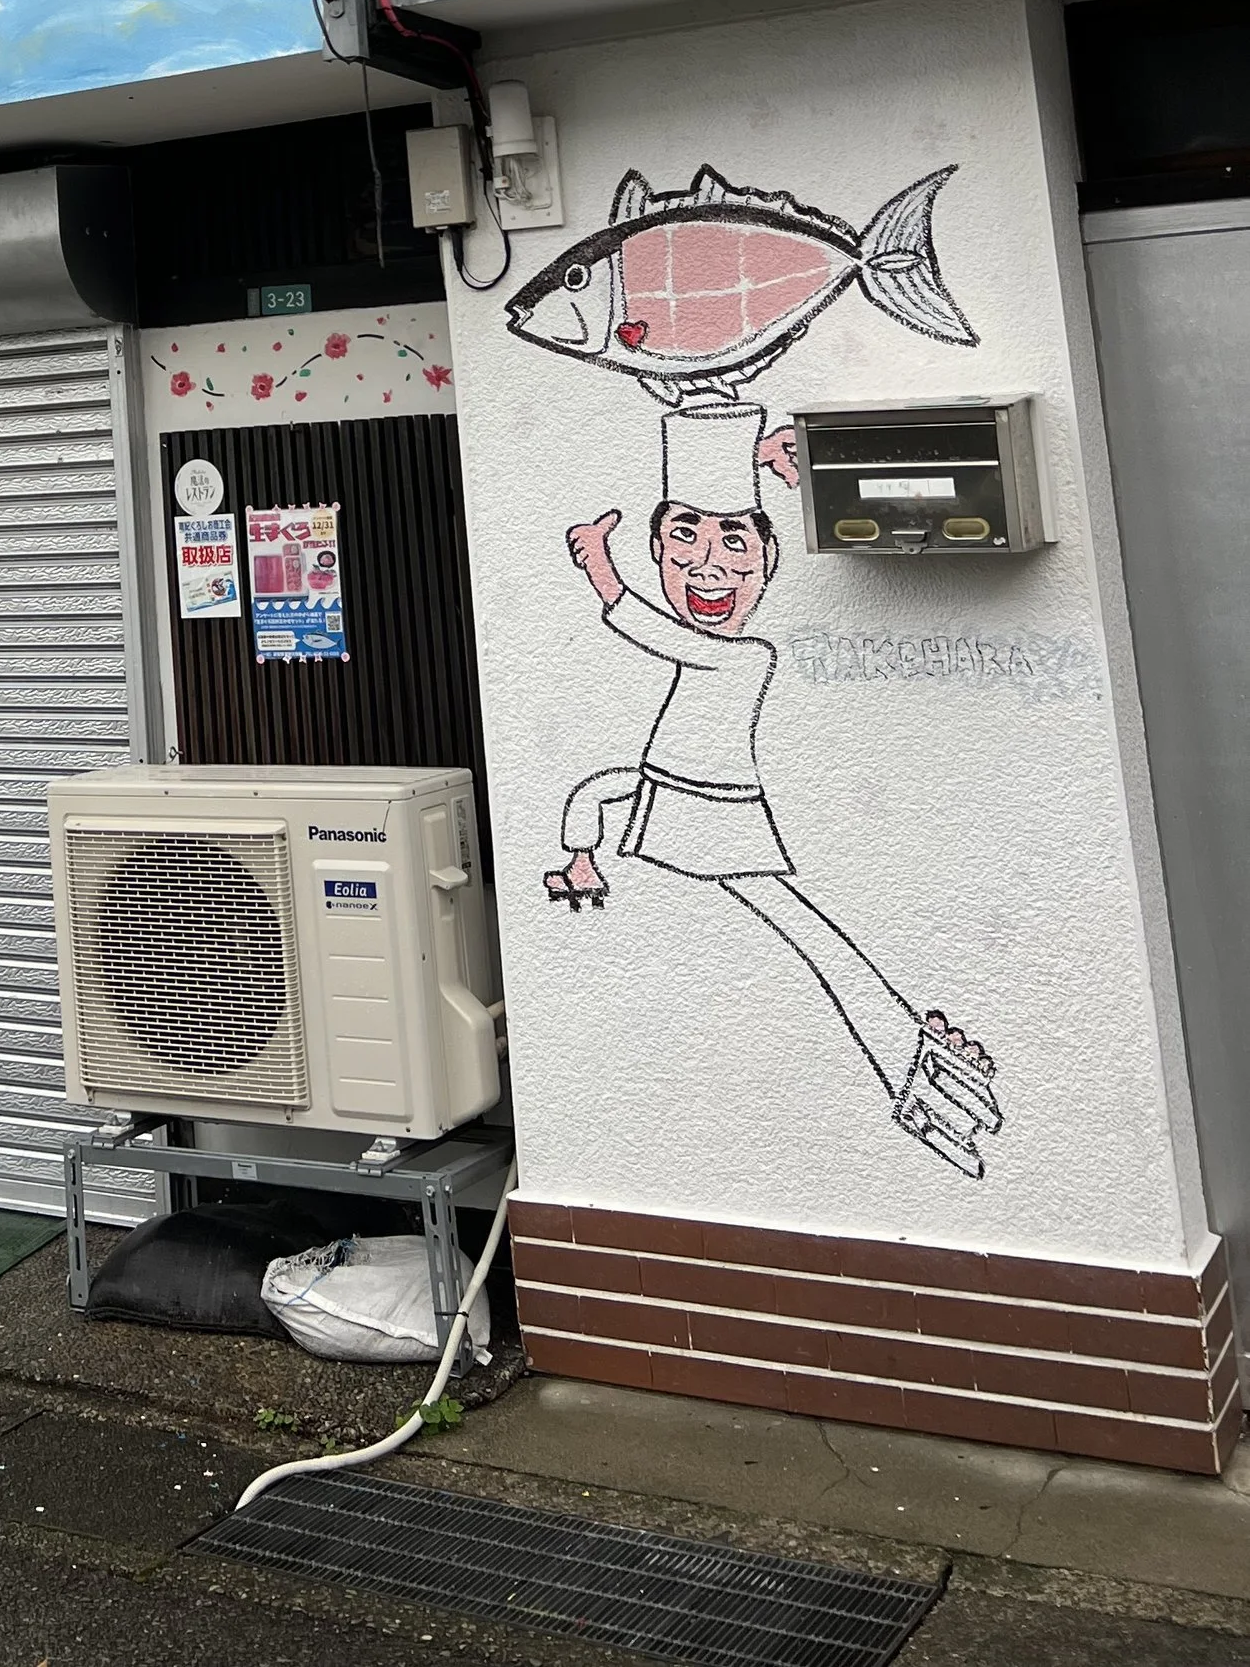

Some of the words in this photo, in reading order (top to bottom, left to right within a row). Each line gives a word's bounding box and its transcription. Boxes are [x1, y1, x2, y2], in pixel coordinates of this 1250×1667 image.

[267, 290, 305, 309] 3-23
[185, 485, 216, 502] レストラン
[312, 521, 335, 531] 12/31
[181, 544, 234, 567] 取扱店
[308, 825, 387, 843] Panasonic
[334, 882, 367, 897] Eolia
